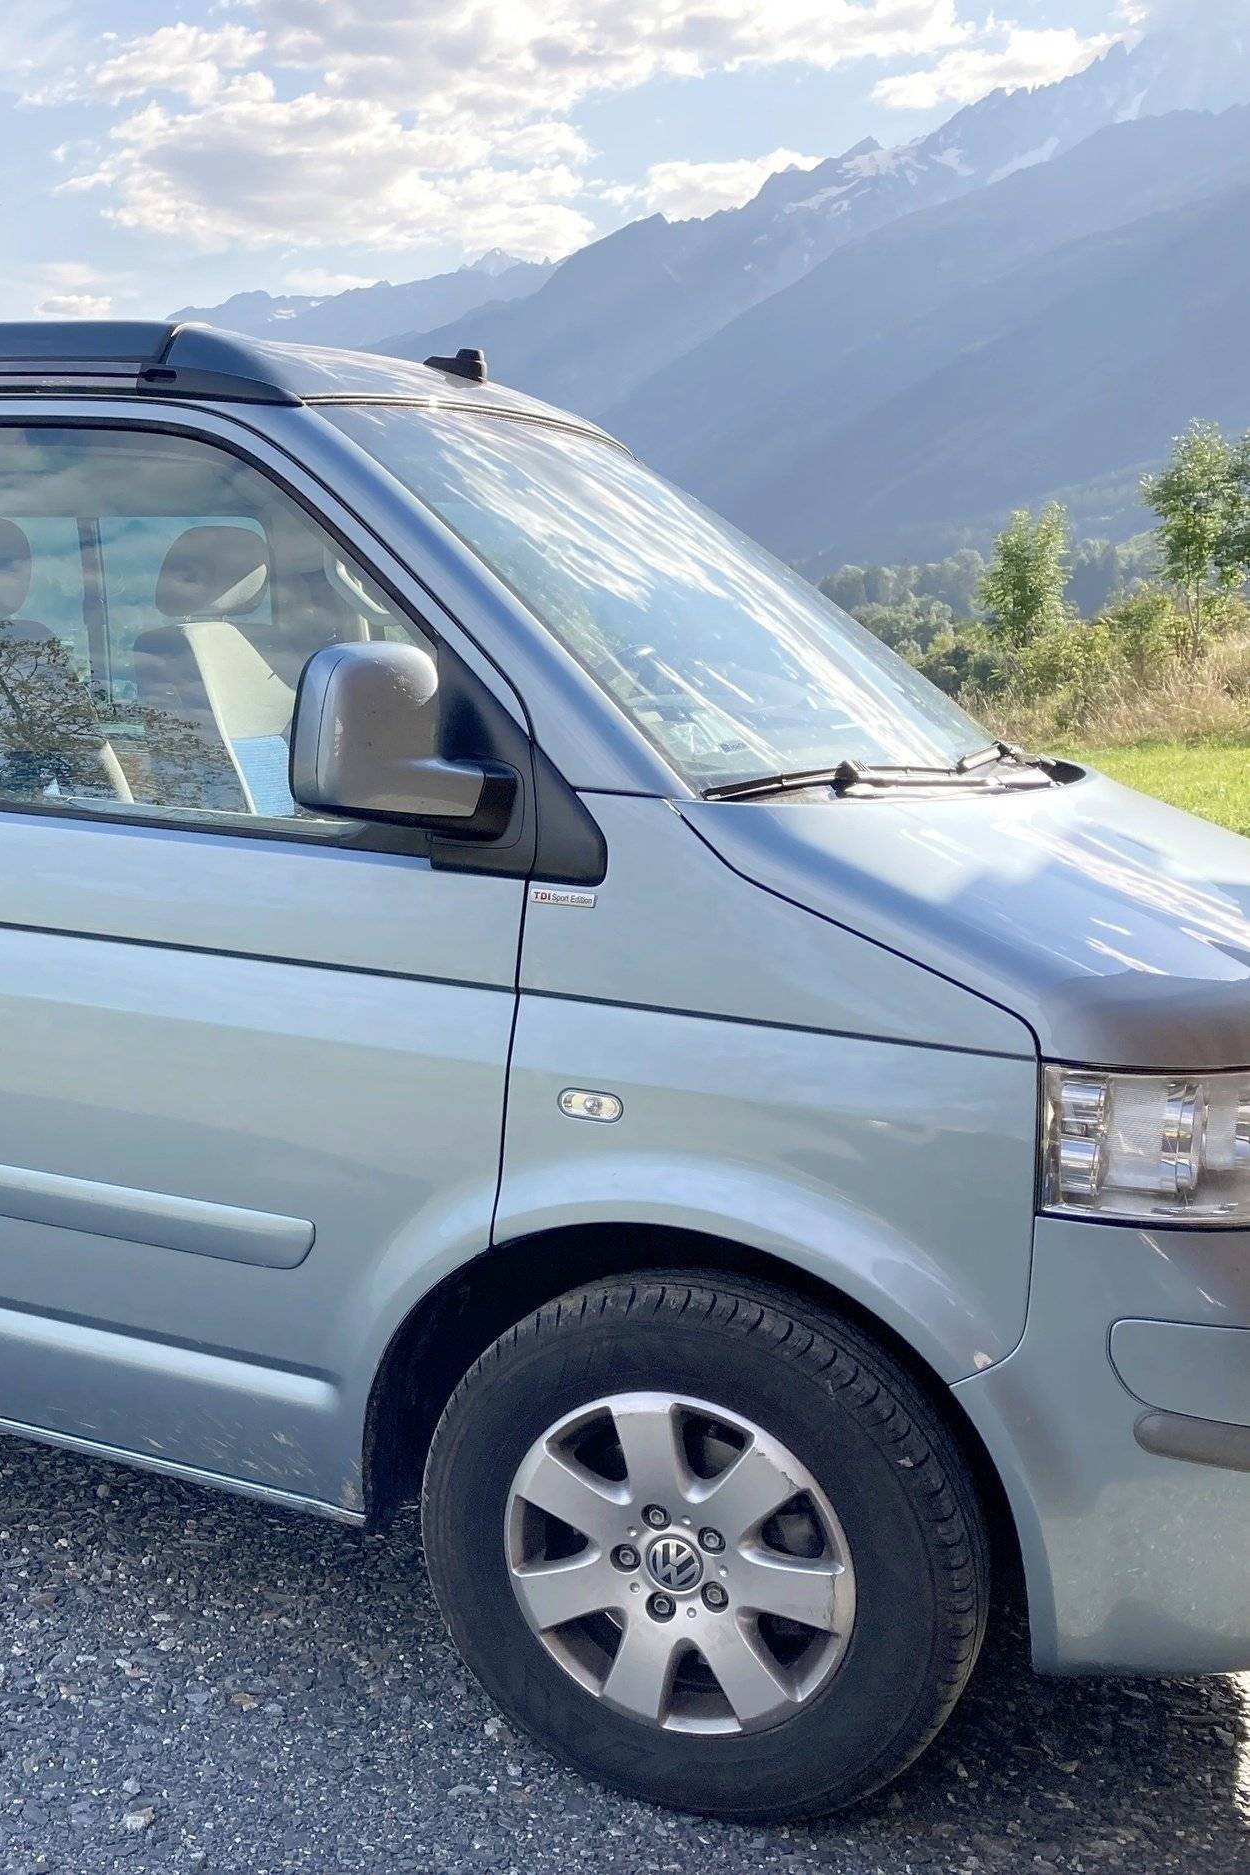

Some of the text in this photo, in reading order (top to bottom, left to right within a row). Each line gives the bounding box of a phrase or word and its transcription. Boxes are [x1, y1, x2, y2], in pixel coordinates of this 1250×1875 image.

[534, 891, 593, 905] TDI Sport Edition
[649, 1539, 700, 1589] VW
